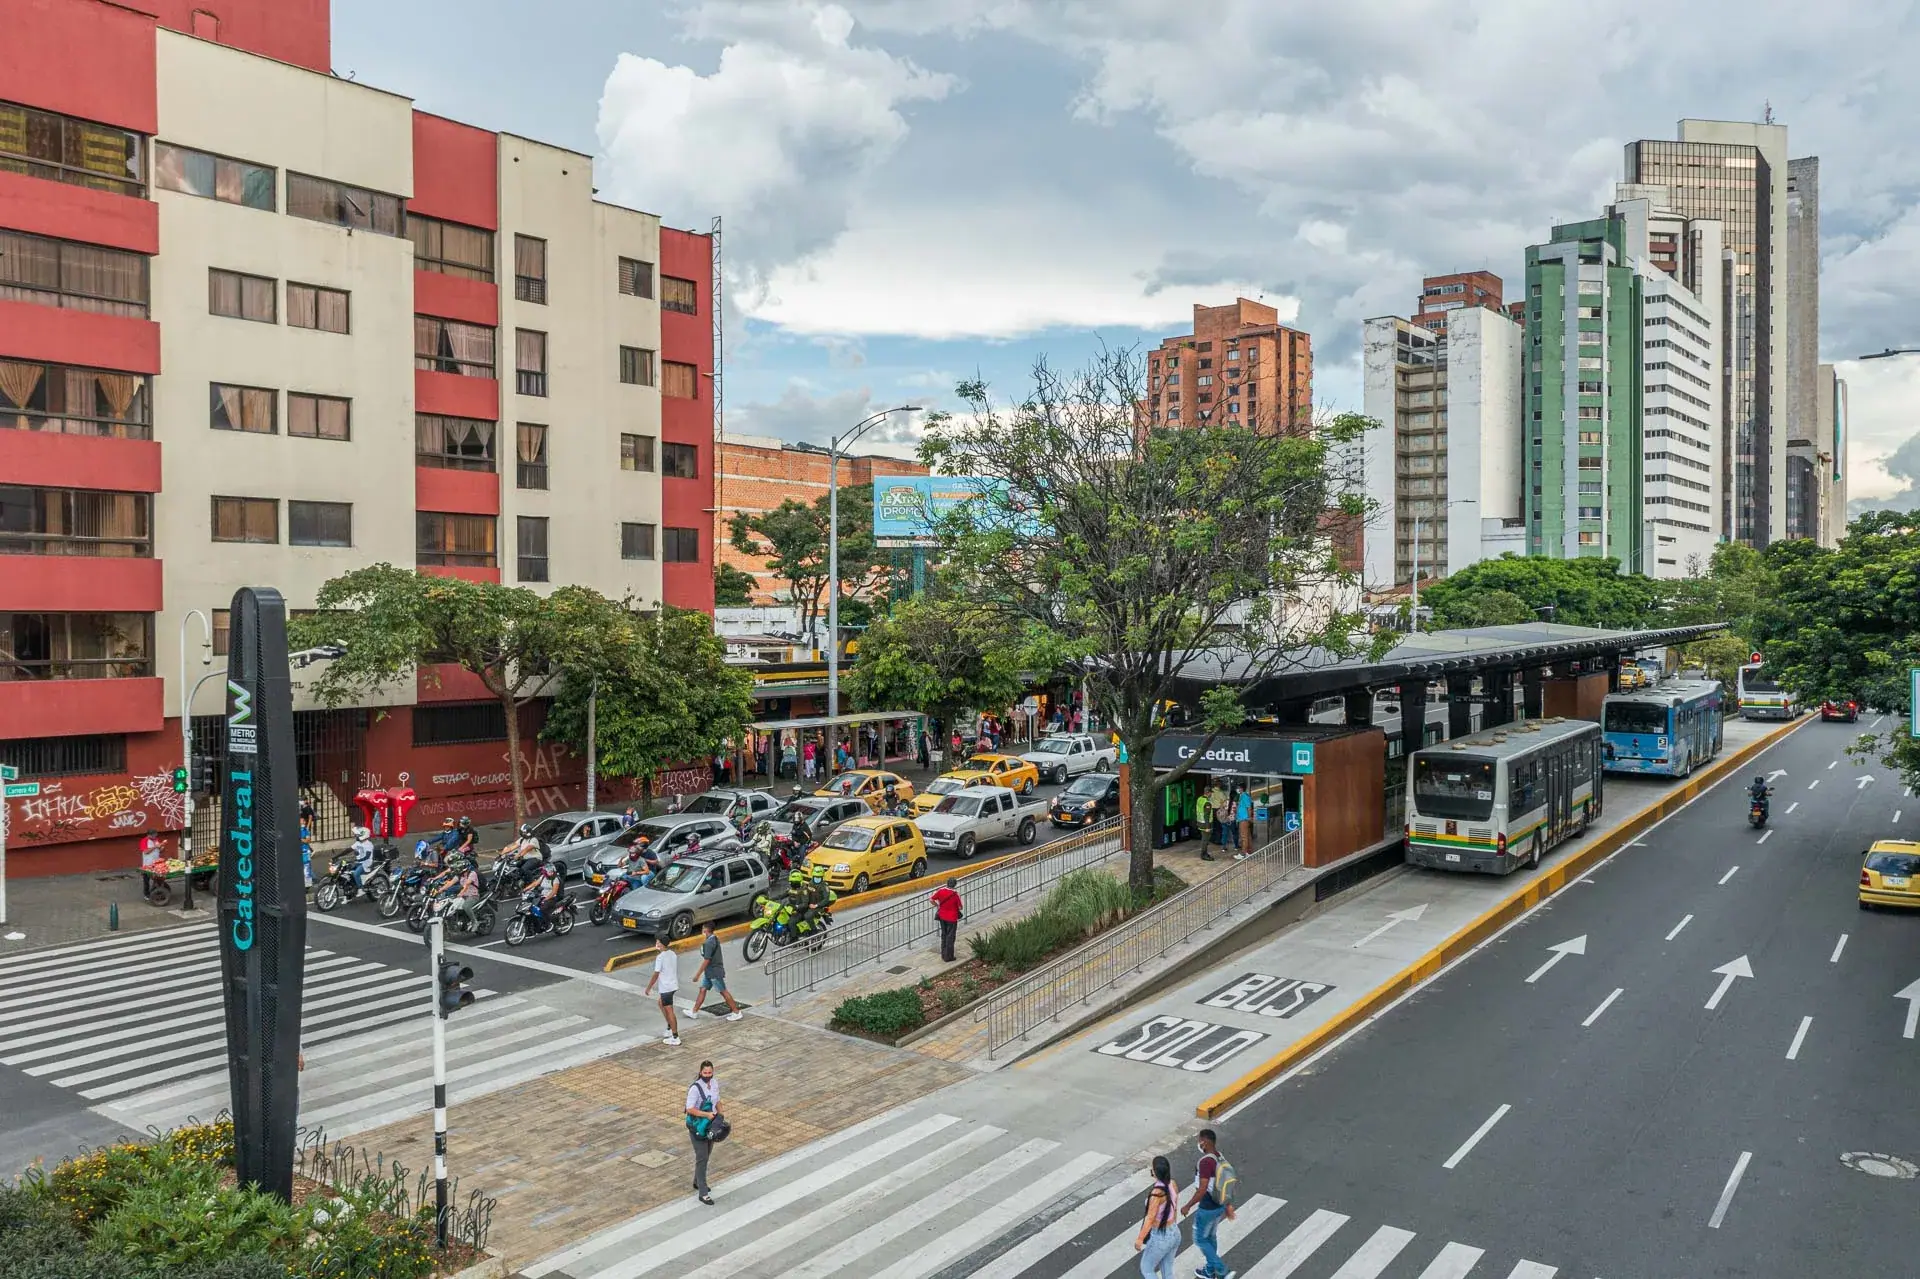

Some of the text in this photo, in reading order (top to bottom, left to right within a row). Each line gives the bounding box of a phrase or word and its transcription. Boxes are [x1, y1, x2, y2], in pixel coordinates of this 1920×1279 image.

[230, 728, 256, 738] METRO
[1178, 746, 1250, 762] Caedral
[232, 771, 255, 950] Catedral
[1203, 973, 1327, 1016] BUS
[1099, 1015, 1265, 1072] SOLO
